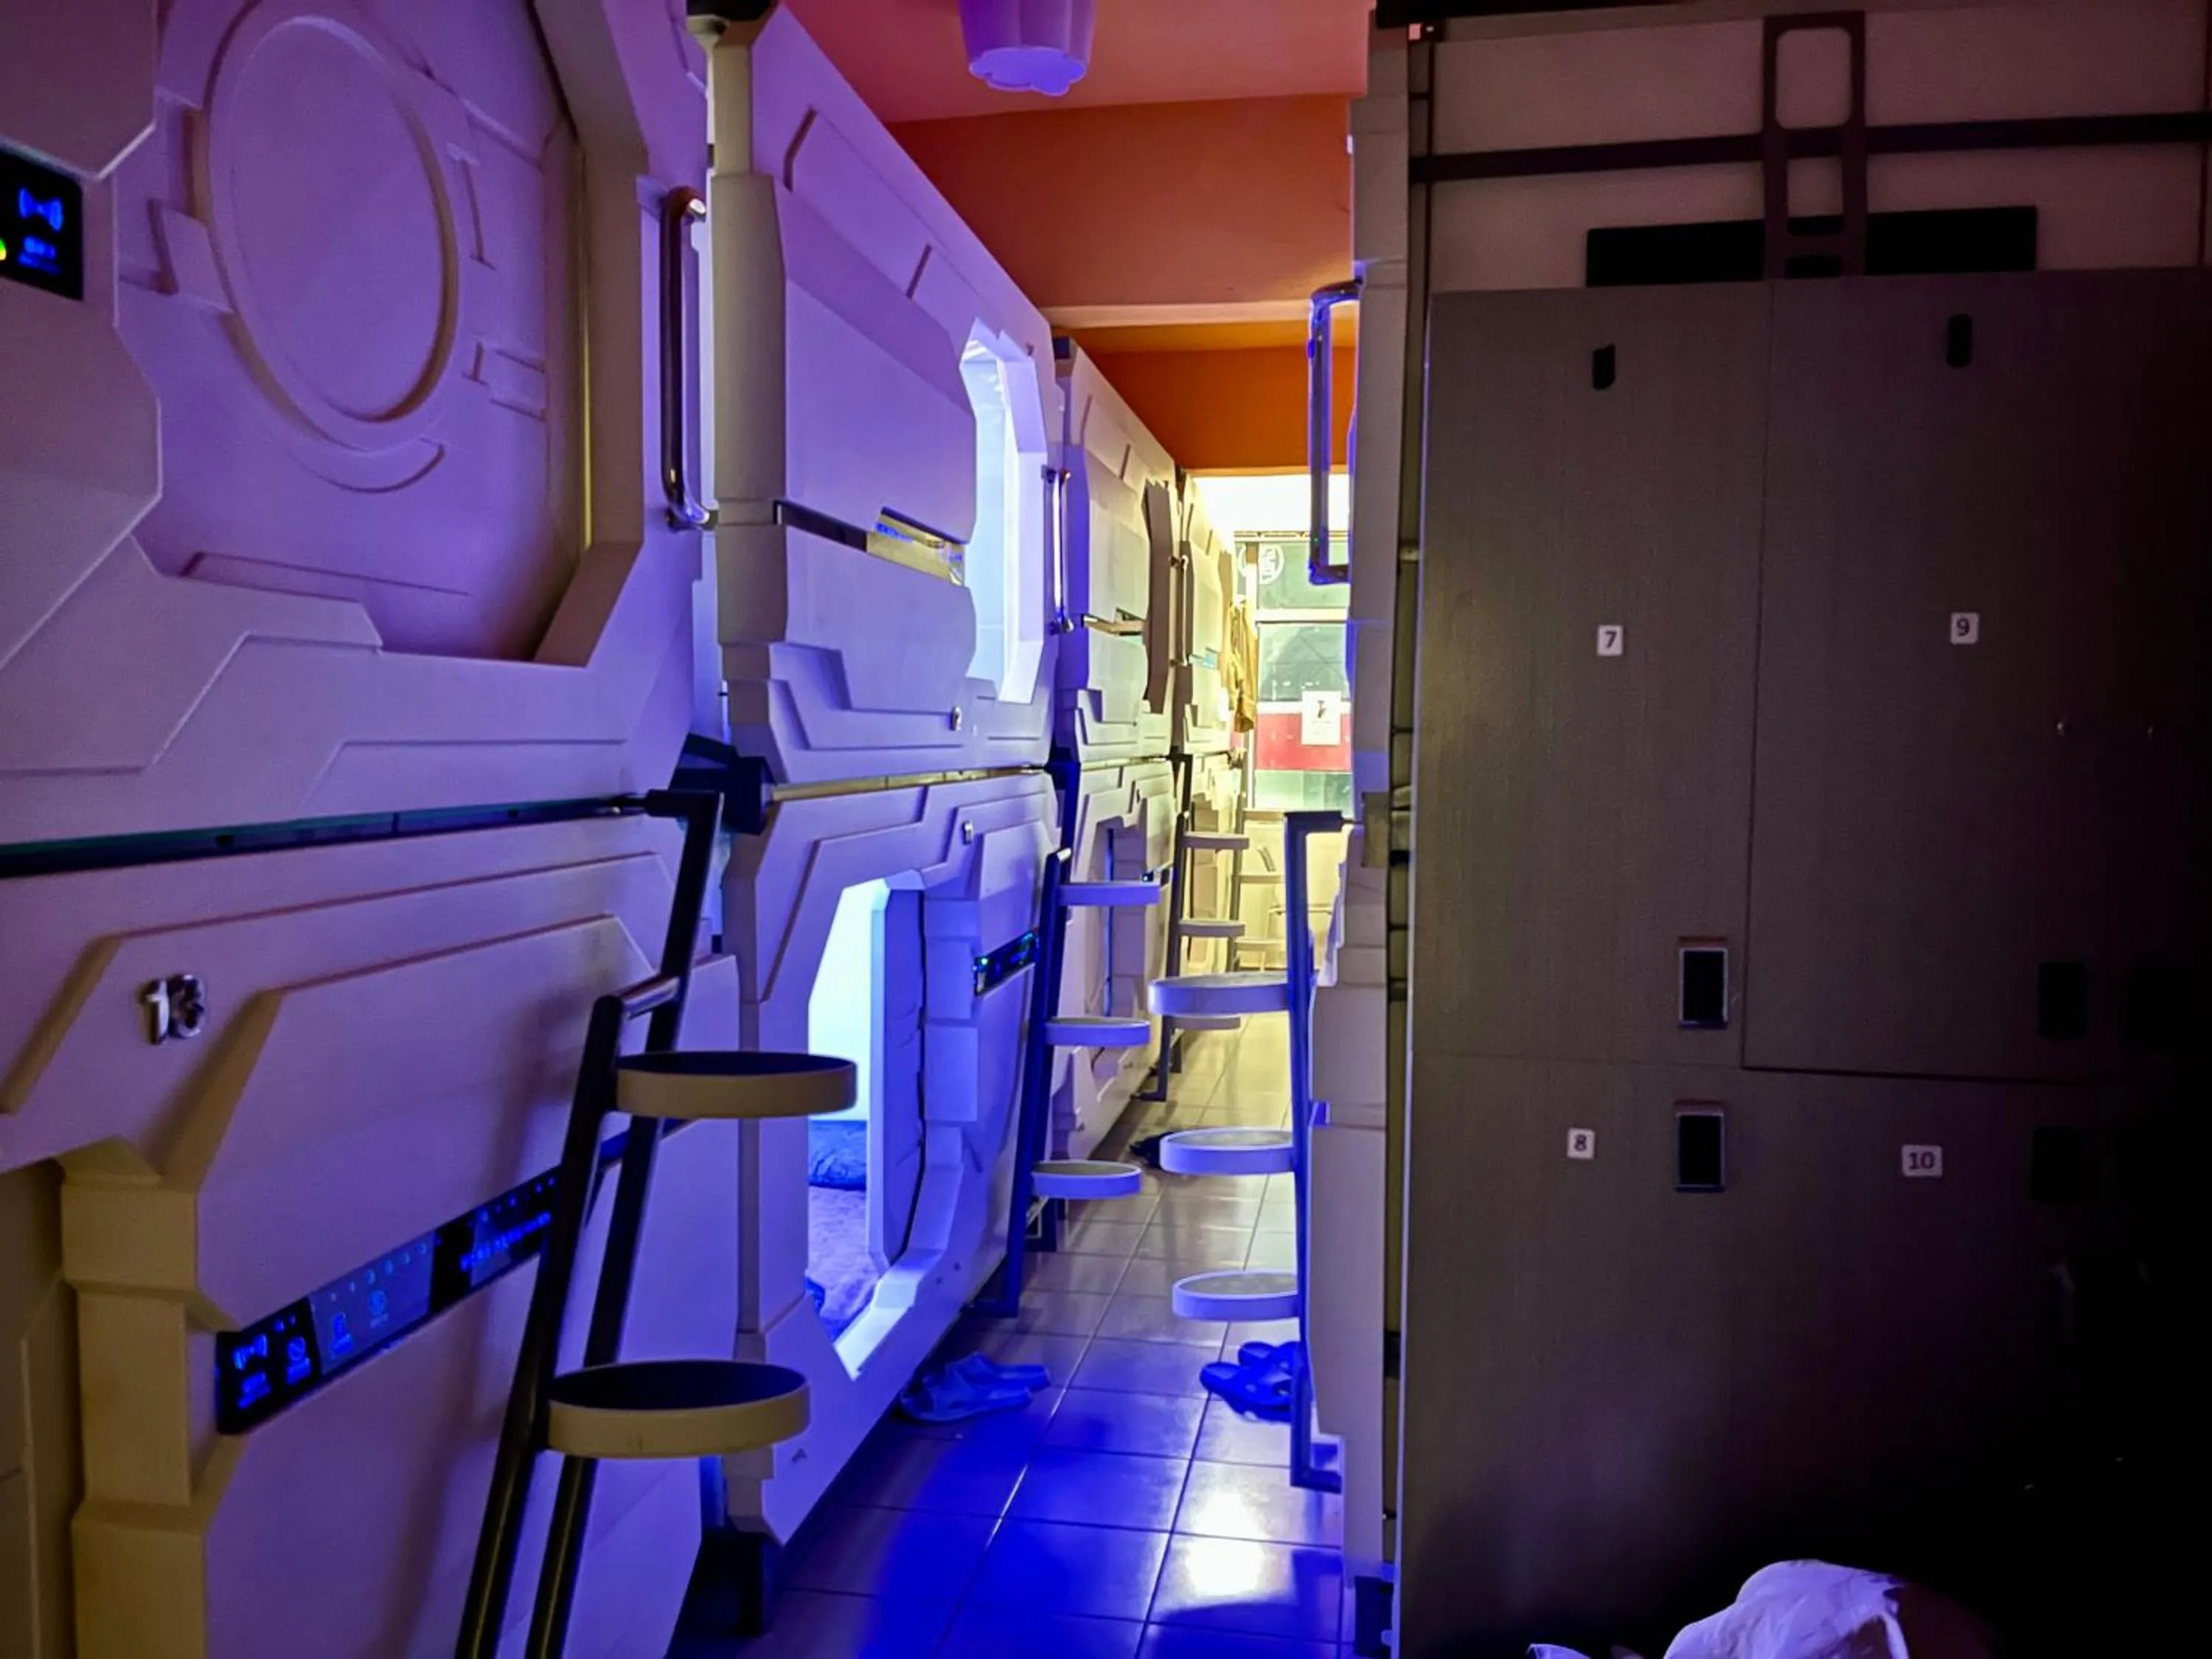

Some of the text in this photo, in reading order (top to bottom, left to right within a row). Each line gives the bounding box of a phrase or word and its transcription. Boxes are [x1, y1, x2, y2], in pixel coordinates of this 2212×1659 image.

[1955, 617, 1971, 637] 9
[1604, 630, 1618, 649] 7
[1573, 1134, 1587, 1152] 8
[1908, 1152, 1935, 1170] 10
